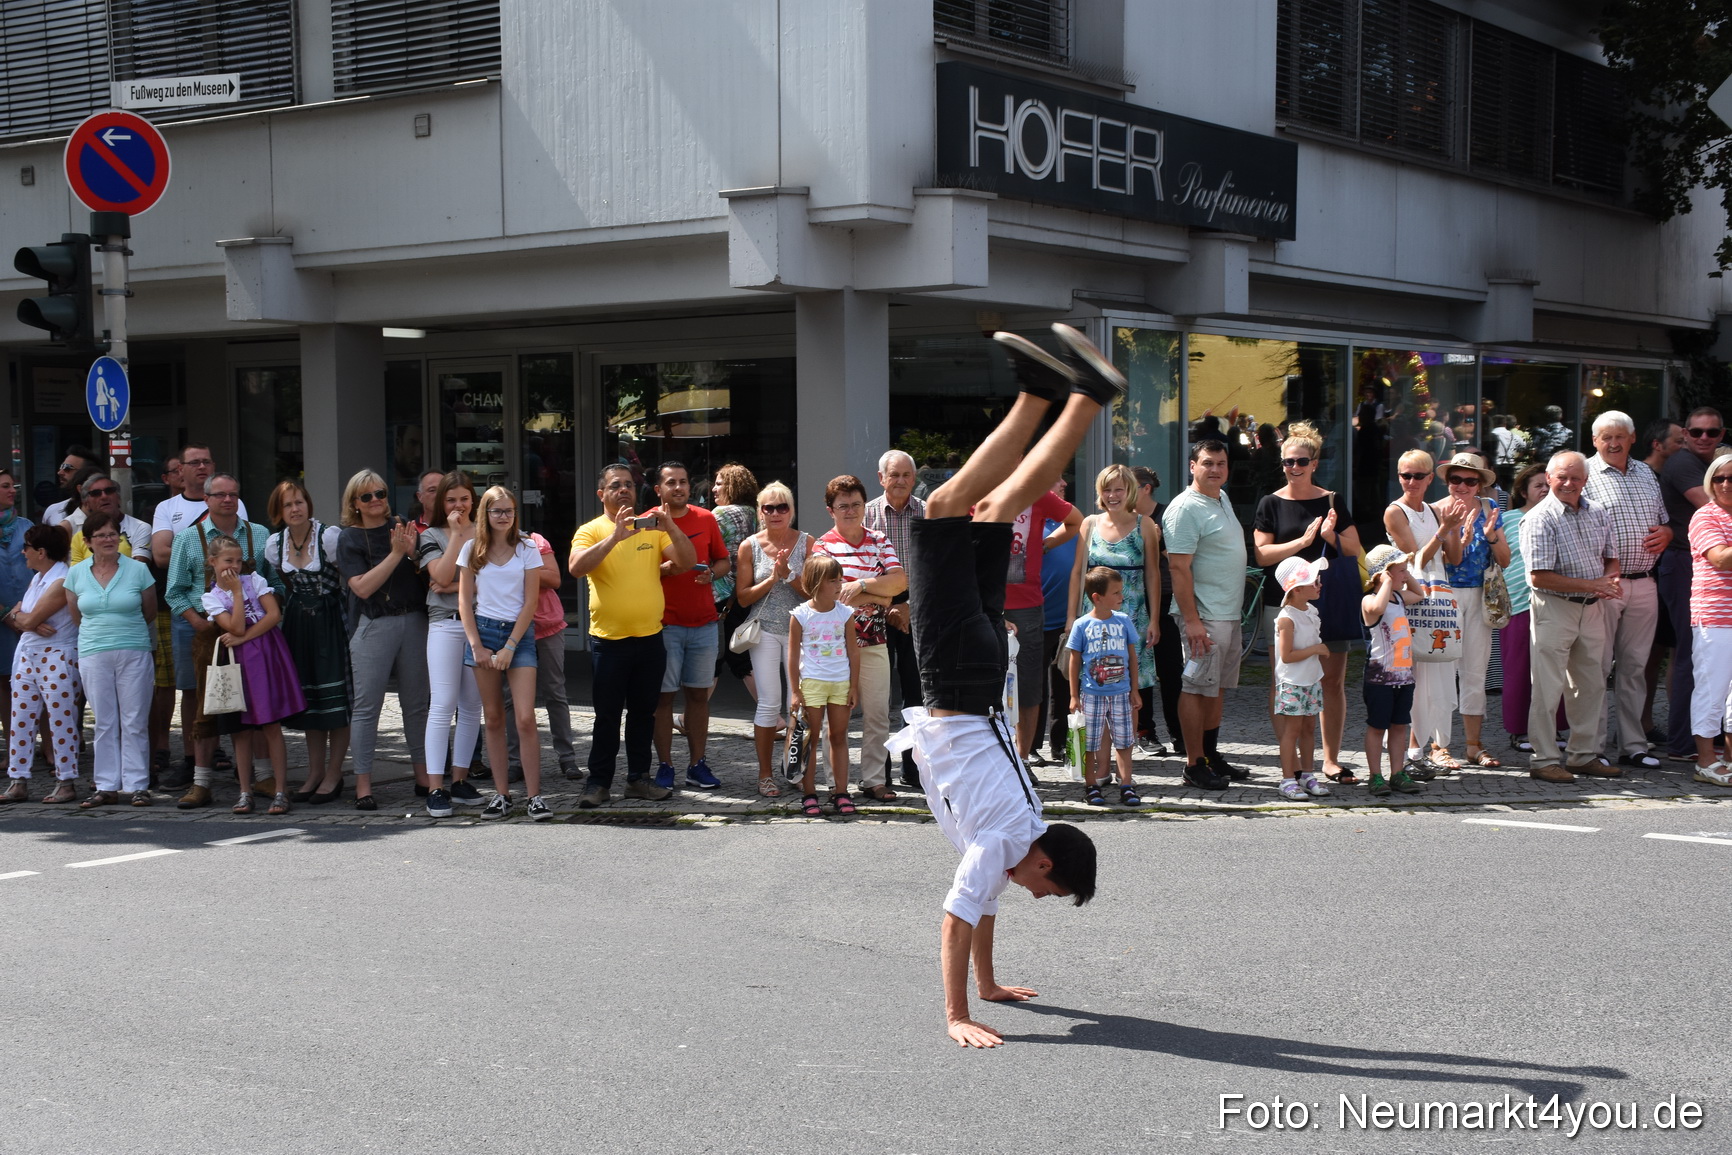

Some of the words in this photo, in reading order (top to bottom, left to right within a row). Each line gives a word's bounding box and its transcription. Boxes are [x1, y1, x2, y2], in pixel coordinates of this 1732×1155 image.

[130, 85, 164, 103] Fußweg
[164, 86, 175, 98] zu
[176, 82, 193, 97] den
[193, 81, 228, 97] Museen
[1172, 161, 1290, 224] Parfümerien
[1431, 598, 1452, 607] SIND
[1421, 608, 1457, 618] KLEINEN
[1407, 618, 1432, 628] REISE
[1085, 623, 1124, 640] READY
[1088, 638, 1125, 653] ACION!
